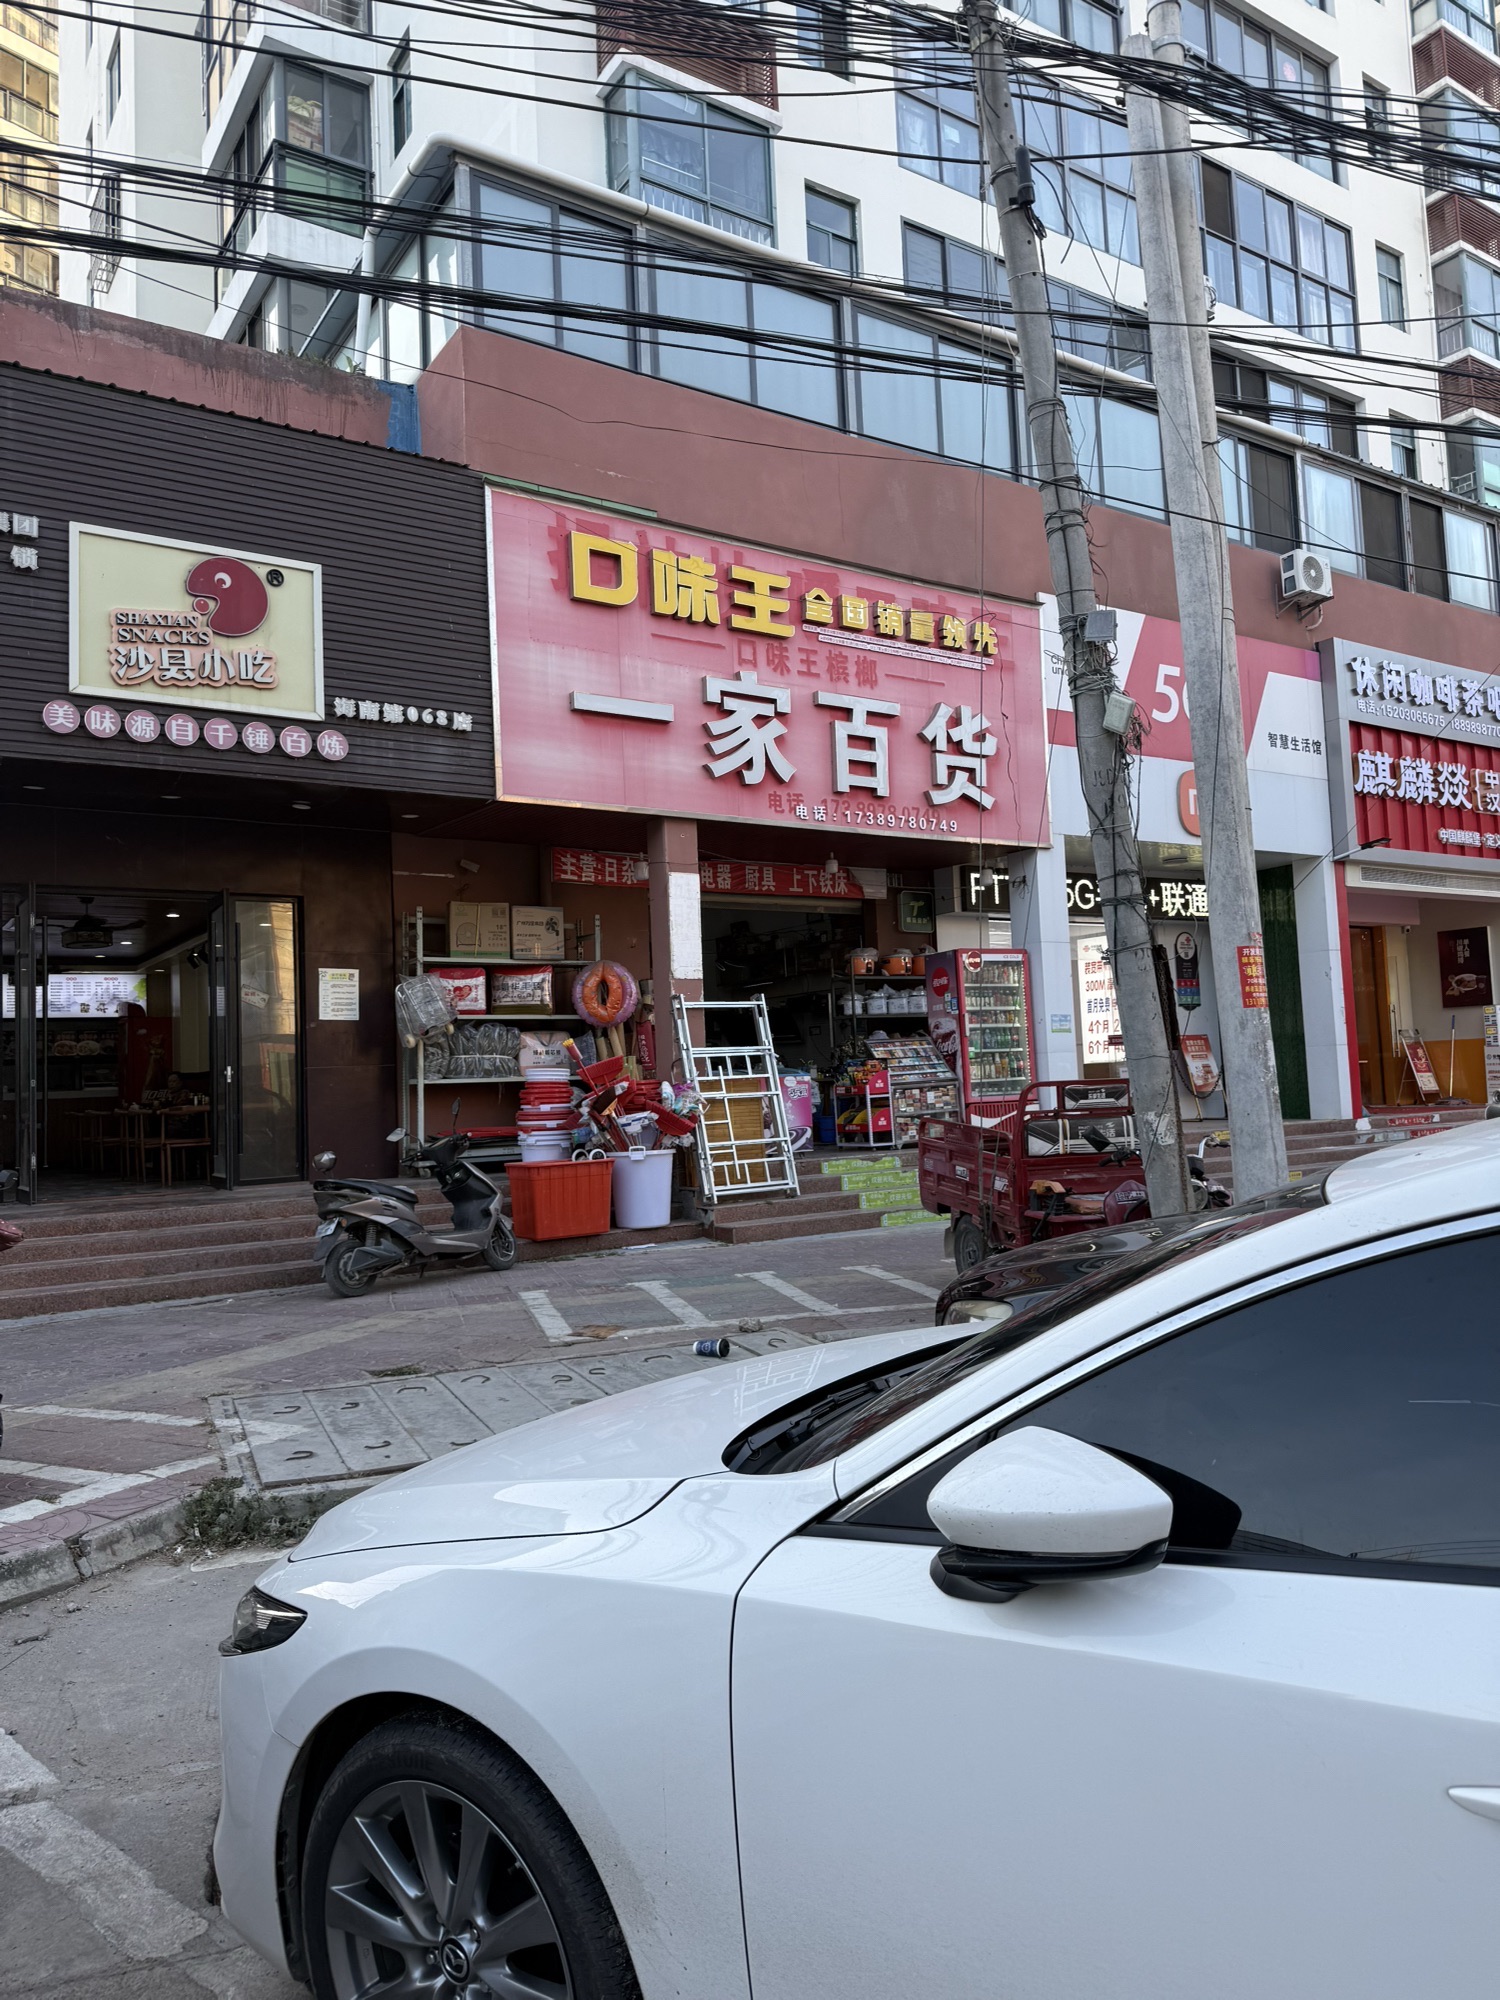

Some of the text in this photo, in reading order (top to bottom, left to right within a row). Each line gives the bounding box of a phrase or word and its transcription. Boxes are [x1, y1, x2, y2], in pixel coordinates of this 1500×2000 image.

[567, 529, 796, 639] 口味王
[116, 612, 199, 629] SHAXIAN
[118, 628, 212, 646] SNACKS
[802, 587, 999, 656] 全国销量领先
[115, 646, 274, 684] 沙县小吃
[1151, 663, 1190, 723] 5
[47, 703, 345, 757] 美味源自千锤百炼
[334, 697, 473, 732] 海南第068店
[569, 670, 999, 812] 一家百货
[1267, 731, 1322, 756] 智慧生活馆
[745, 865, 776, 892] 厨具
